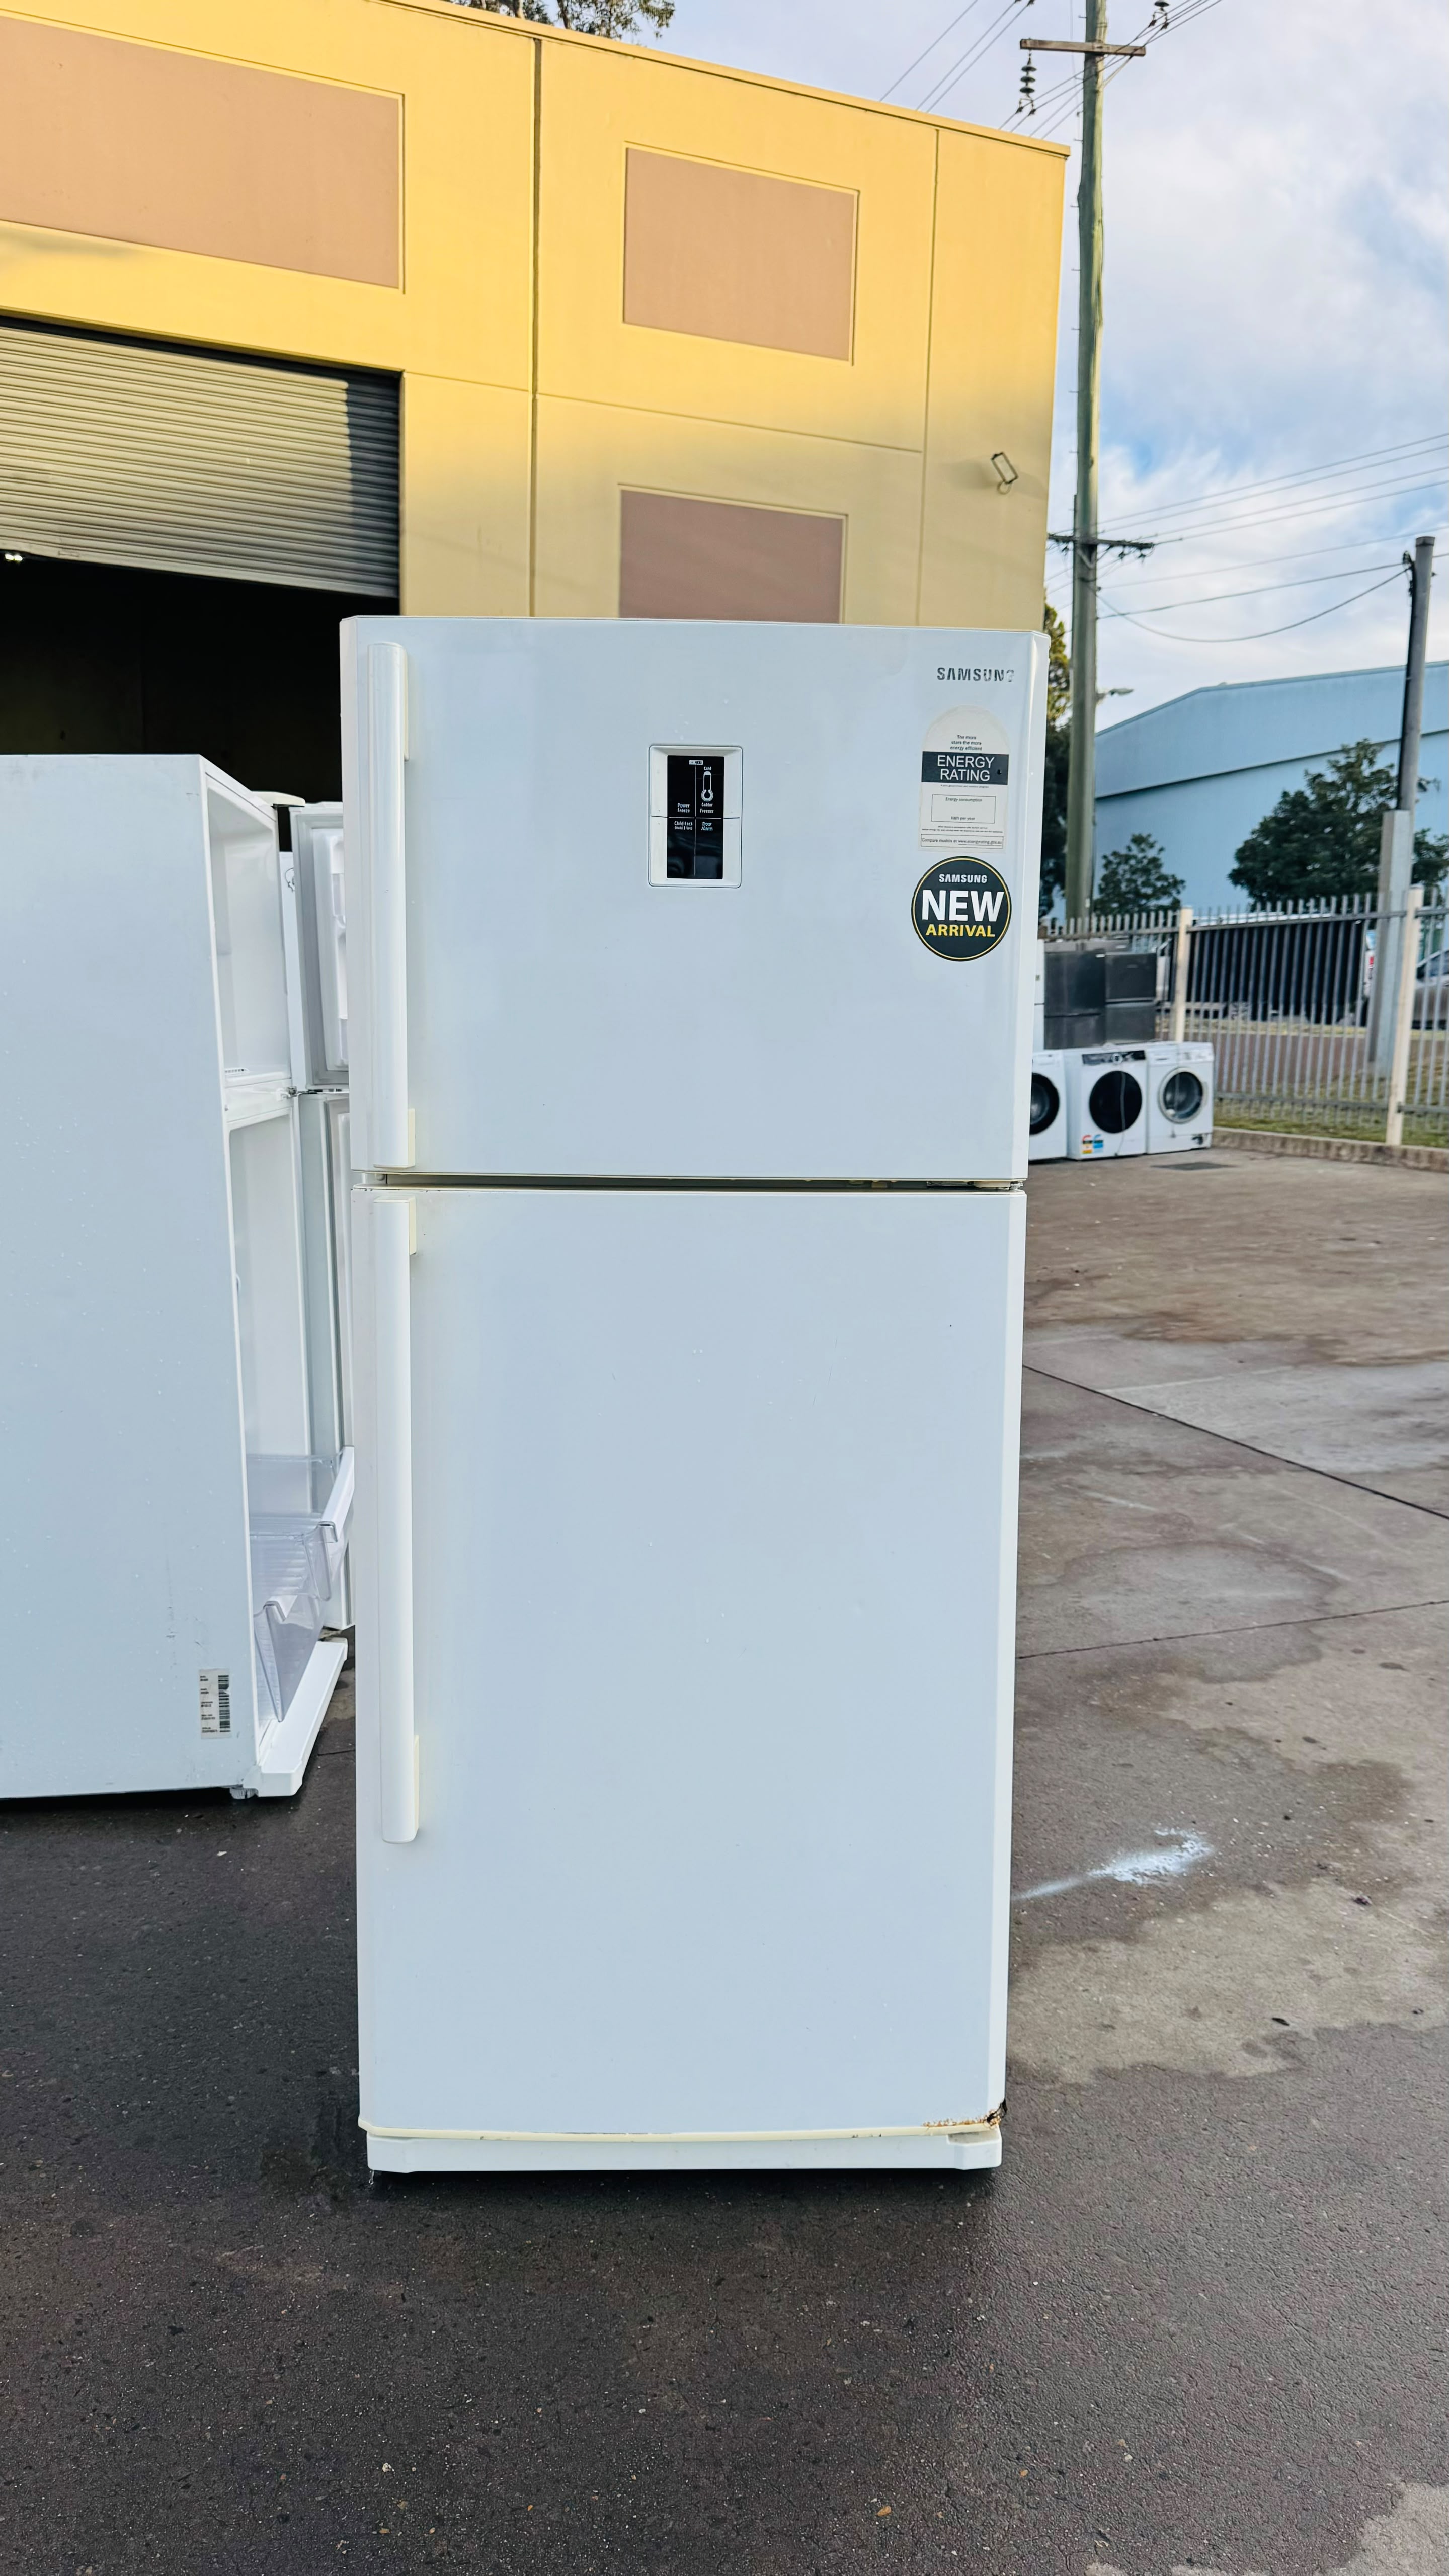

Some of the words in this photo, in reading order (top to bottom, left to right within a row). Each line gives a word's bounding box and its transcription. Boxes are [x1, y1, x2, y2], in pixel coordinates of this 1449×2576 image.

[937, 755, 995, 768] ENERGY
[940, 769, 990, 782] RATING
[939, 873, 987, 883] SAMSUNG
[922, 889, 1004, 922] NEW
[925, 924, 995, 937] ARRIVAL
